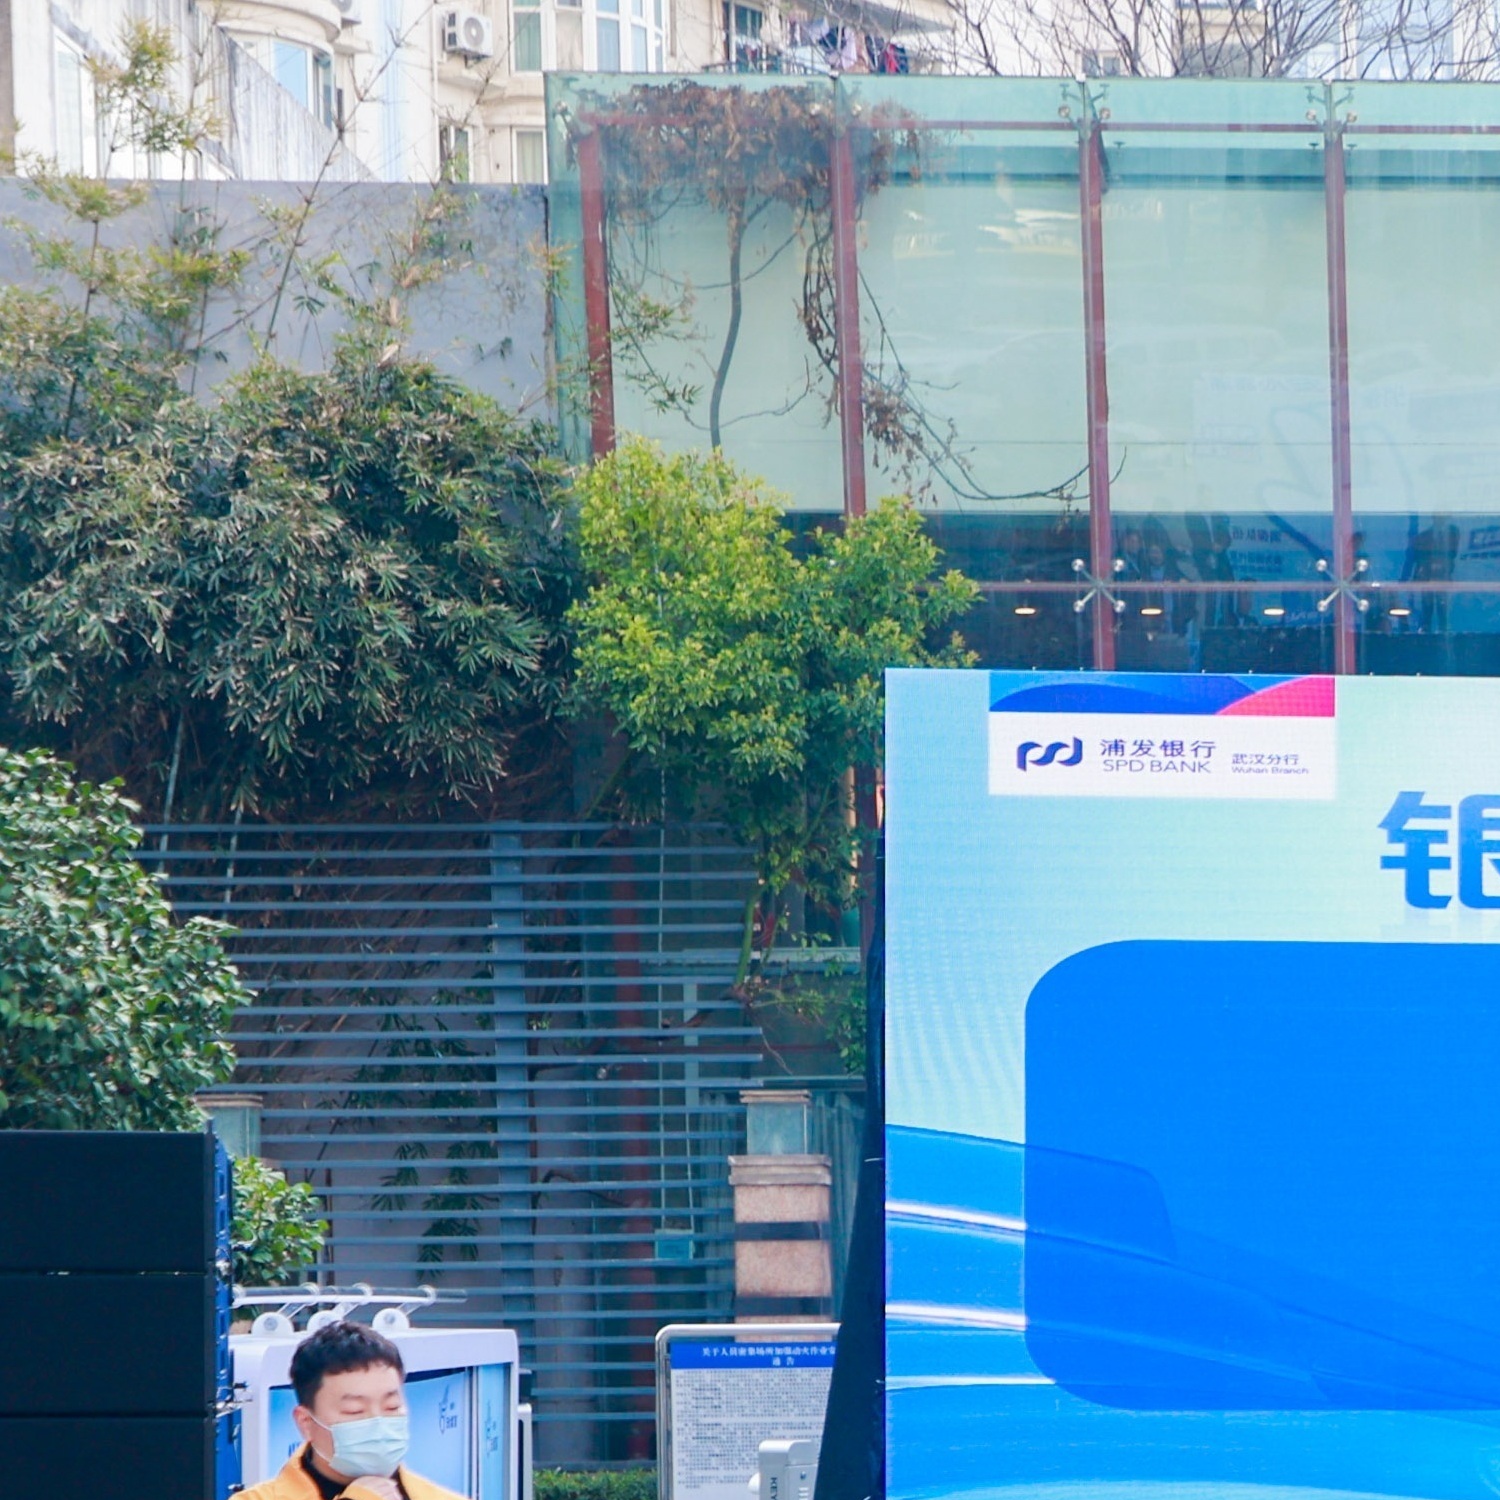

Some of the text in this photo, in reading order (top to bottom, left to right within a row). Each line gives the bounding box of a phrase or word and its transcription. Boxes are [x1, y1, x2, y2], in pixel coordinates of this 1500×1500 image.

[1099, 738, 1217, 759] 浦发银行
[1102, 760, 1212, 774] SPD BANK
[1231, 753, 1299, 767] 武汉分行
[1231, 767, 1310, 776] Wuhan Branch
